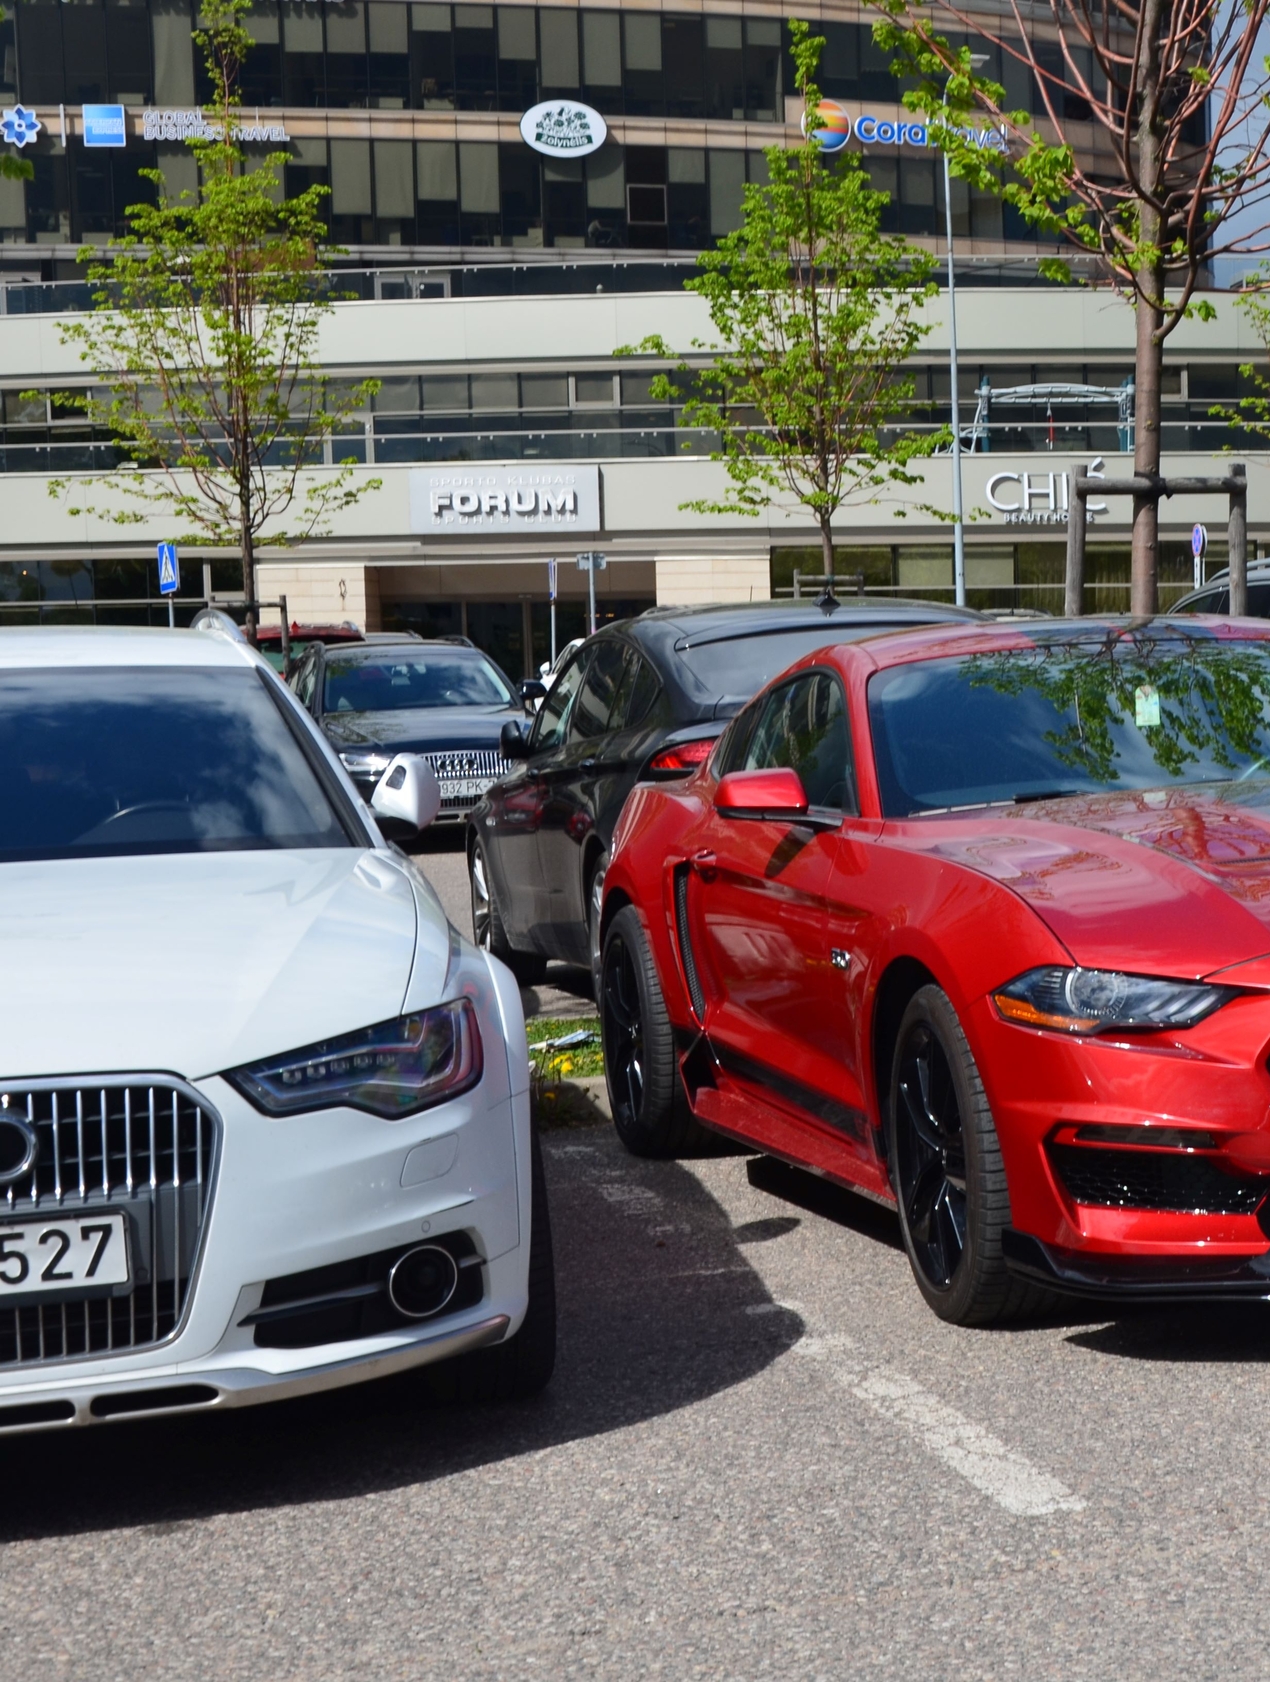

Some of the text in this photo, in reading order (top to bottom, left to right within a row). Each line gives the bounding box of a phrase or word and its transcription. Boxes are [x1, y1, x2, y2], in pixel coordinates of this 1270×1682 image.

[143, 110, 206, 126] GLOBAL
[430, 475, 576, 487] SPORTO KLUBAS
[430, 488, 575, 513] FORUM
[431, 513, 576, 525] SPORTS CLUB
[1003, 512, 1050, 522] BEAUTY
